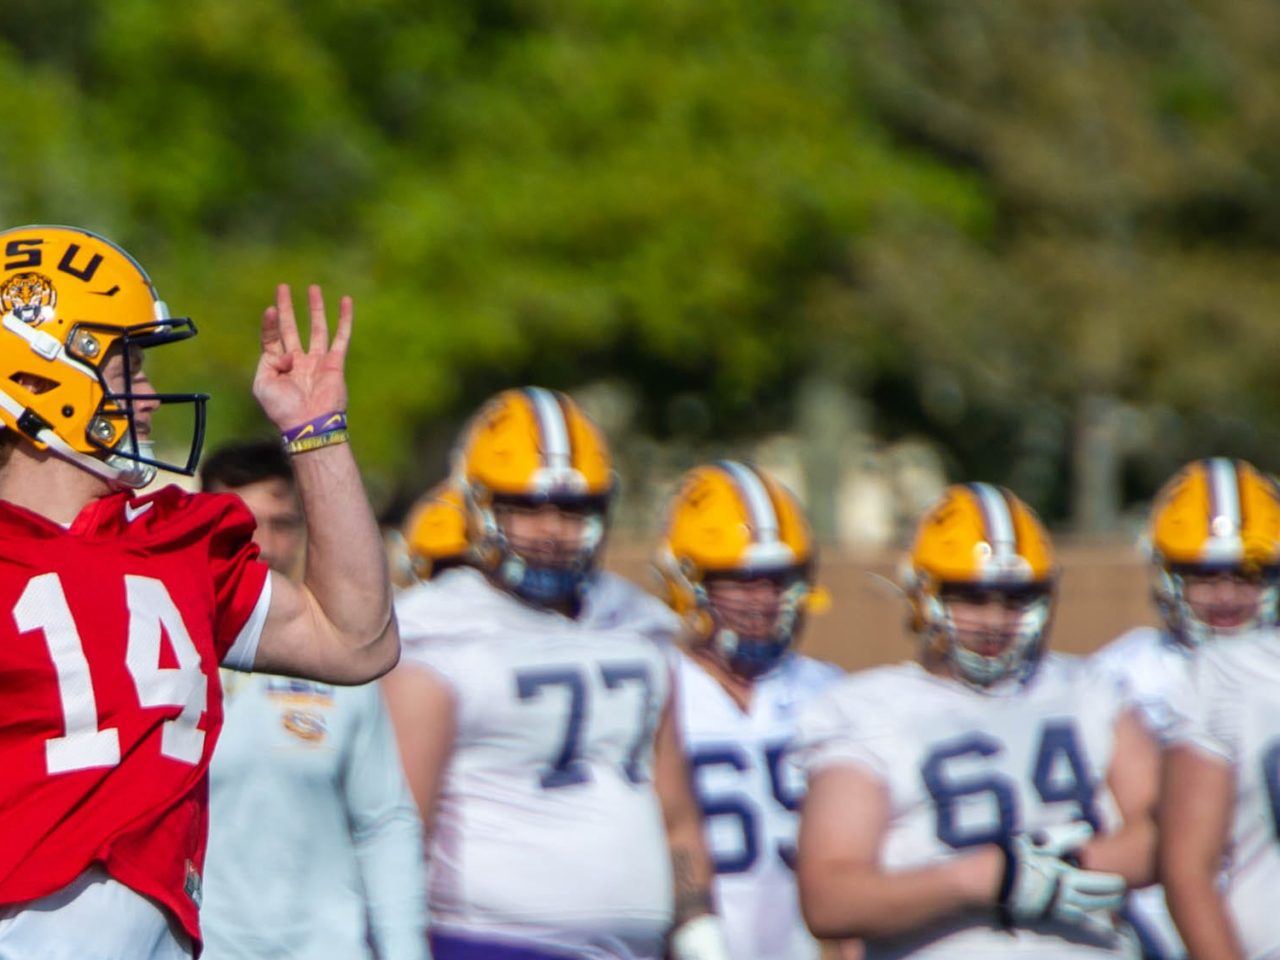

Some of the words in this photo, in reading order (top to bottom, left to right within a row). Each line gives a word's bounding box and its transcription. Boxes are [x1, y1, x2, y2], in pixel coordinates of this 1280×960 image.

[11, 571, 208, 776] 14
[514, 659, 655, 790] 77
[921, 714, 1104, 850] 64
